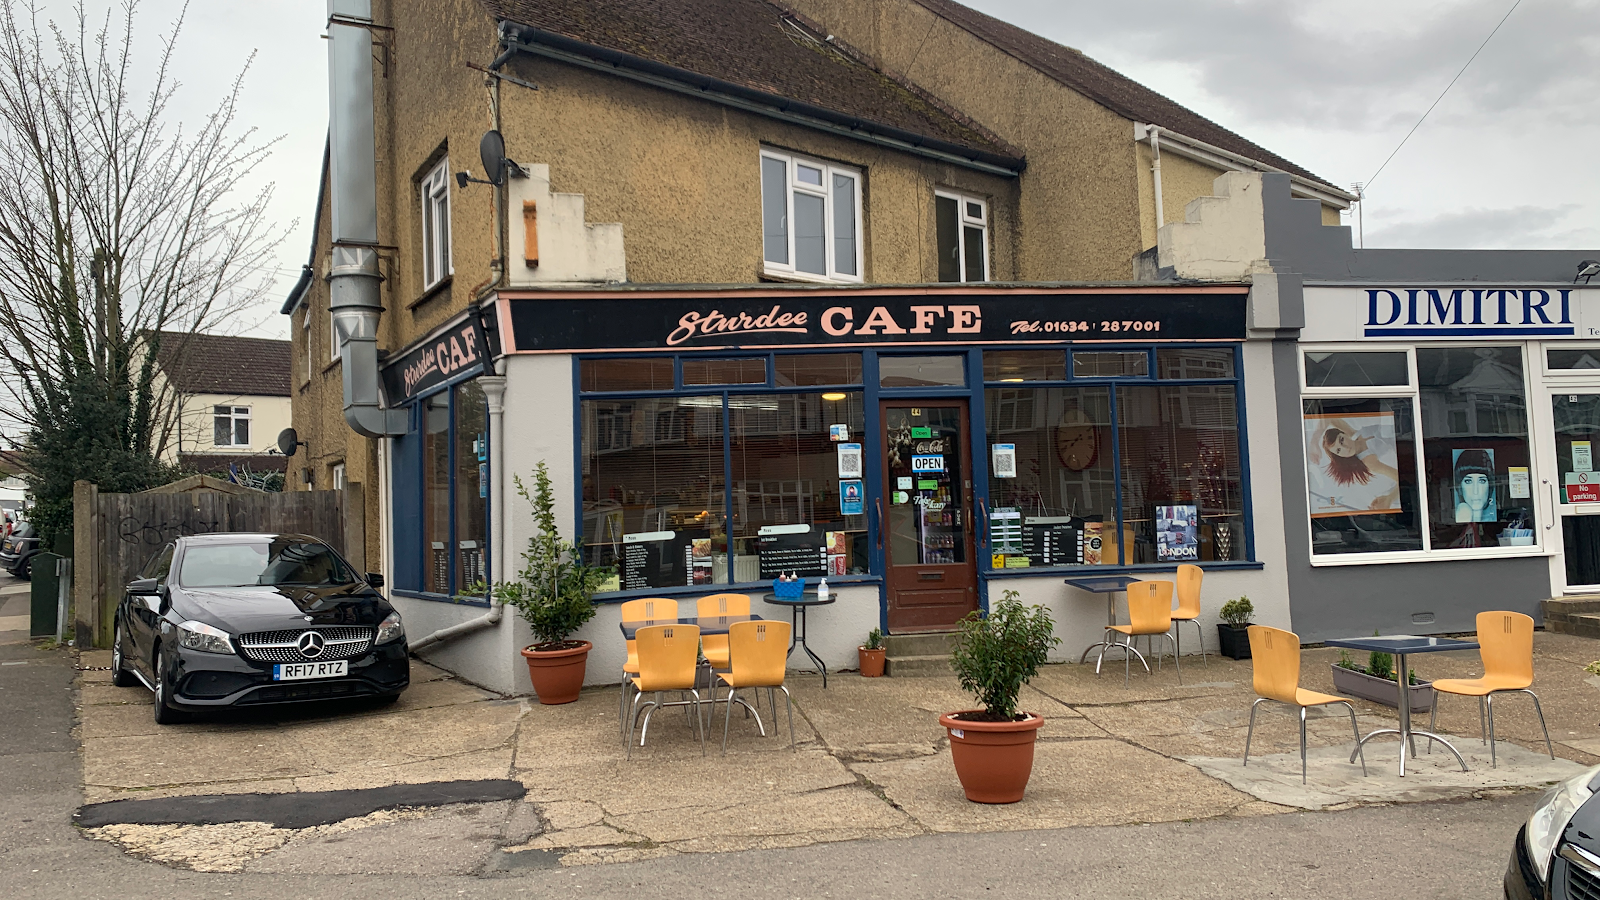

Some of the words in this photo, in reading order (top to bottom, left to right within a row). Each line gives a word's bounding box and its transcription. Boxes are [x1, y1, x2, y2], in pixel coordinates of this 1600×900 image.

[1364, 289, 1574, 326] DIMITRI
[666, 304, 808, 346] Sturdee
[820, 304, 982, 337] CAFE
[1101, 320, 1161, 332] 287001
[403, 349, 437, 398] Sturdee
[436, 320, 486, 376] CAF
[915, 458, 941, 470] OPEN
[1573, 493, 1597, 502] parking
[1158, 547, 1196, 557] LONDON
[285, 664, 315, 677] RF17
[318, 661, 343, 675] RTZ
